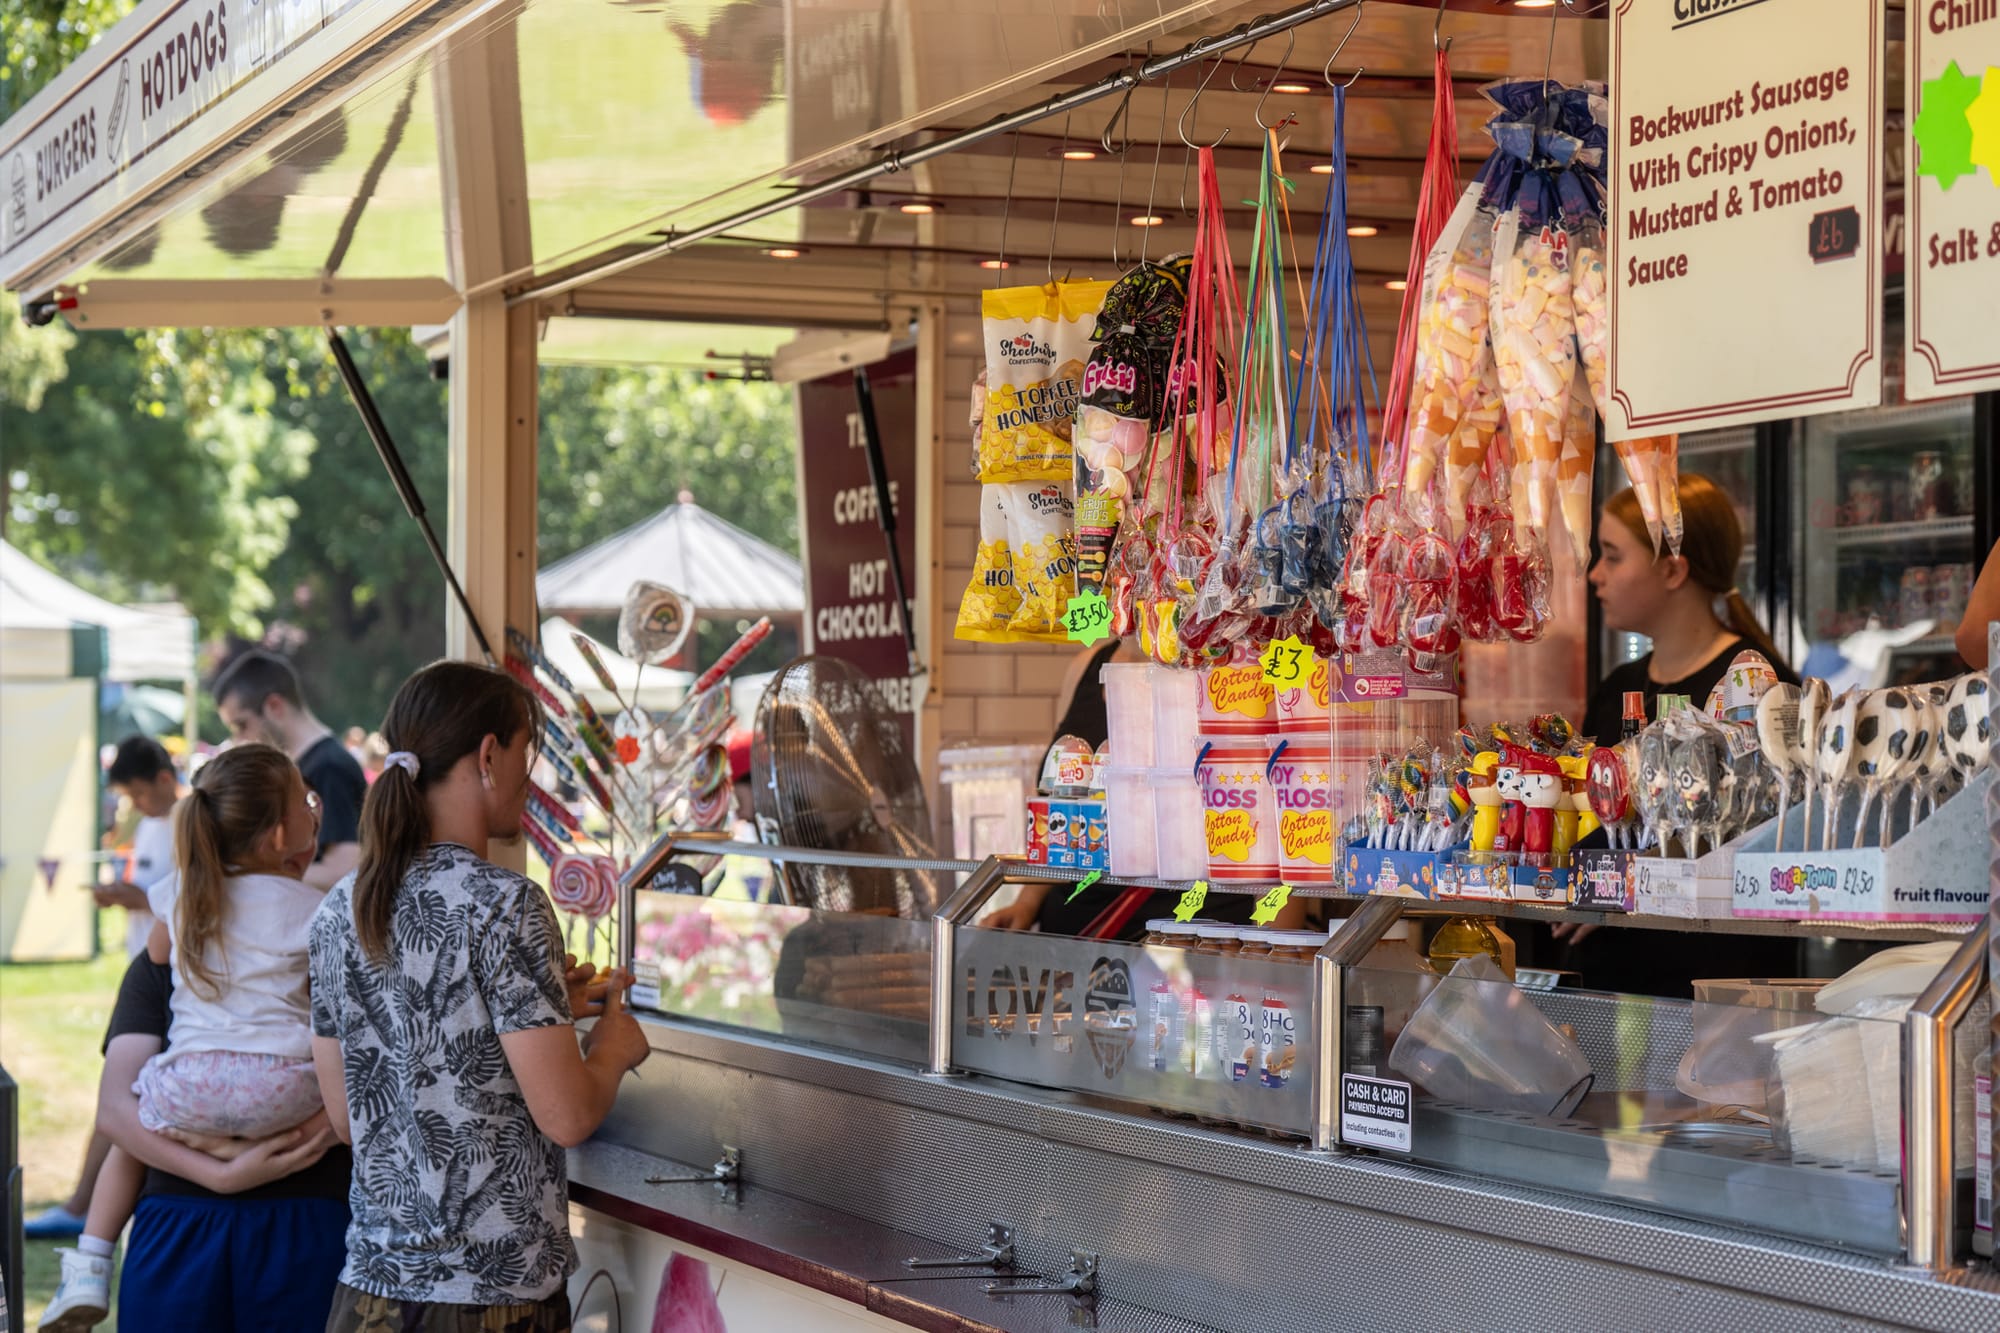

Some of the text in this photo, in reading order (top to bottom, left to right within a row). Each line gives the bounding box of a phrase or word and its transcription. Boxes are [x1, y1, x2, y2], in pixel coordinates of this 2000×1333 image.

[140, 0, 227, 120] HOTDOGS
[1630, 67, 1849, 147] Bockwurst Sausage
[36, 106, 96, 202] BURGERS
[1629, 116, 1856, 193] With Crispy Onions,
[1628, 168, 1843, 240] Mustard & Tomato
[1928, 227, 1978, 269] Salt
[1628, 254, 1688, 288] Sauce
[1000, 338, 1057, 363] Shoebury
[1013, 380, 1078, 407] TOFFEE
[996, 397, 1079, 431] HONEYCO
[848, 559, 887, 599] HOT
[1069, 601, 1109, 632] £3.50
[1264, 646, 1303, 680] £3
[1210, 670, 1263, 694] Cotton
[1215, 682, 1275, 710] Candy
[1208, 820, 1260, 854] Candy!
[1281, 814, 1328, 839] Cotton
[1734, 870, 1760, 898] £2.50
[1843, 867, 1874, 896] £2.50
[1893, 887, 1990, 902] fruit flavour
[966, 965, 1074, 1053] LOVE
[1347, 1082, 1406, 1106] CASH & CARD
[1348, 1100, 1405, 1119] PAYMENTS ACCEPTED
[1345, 1121, 1396, 1139] Including contactless
